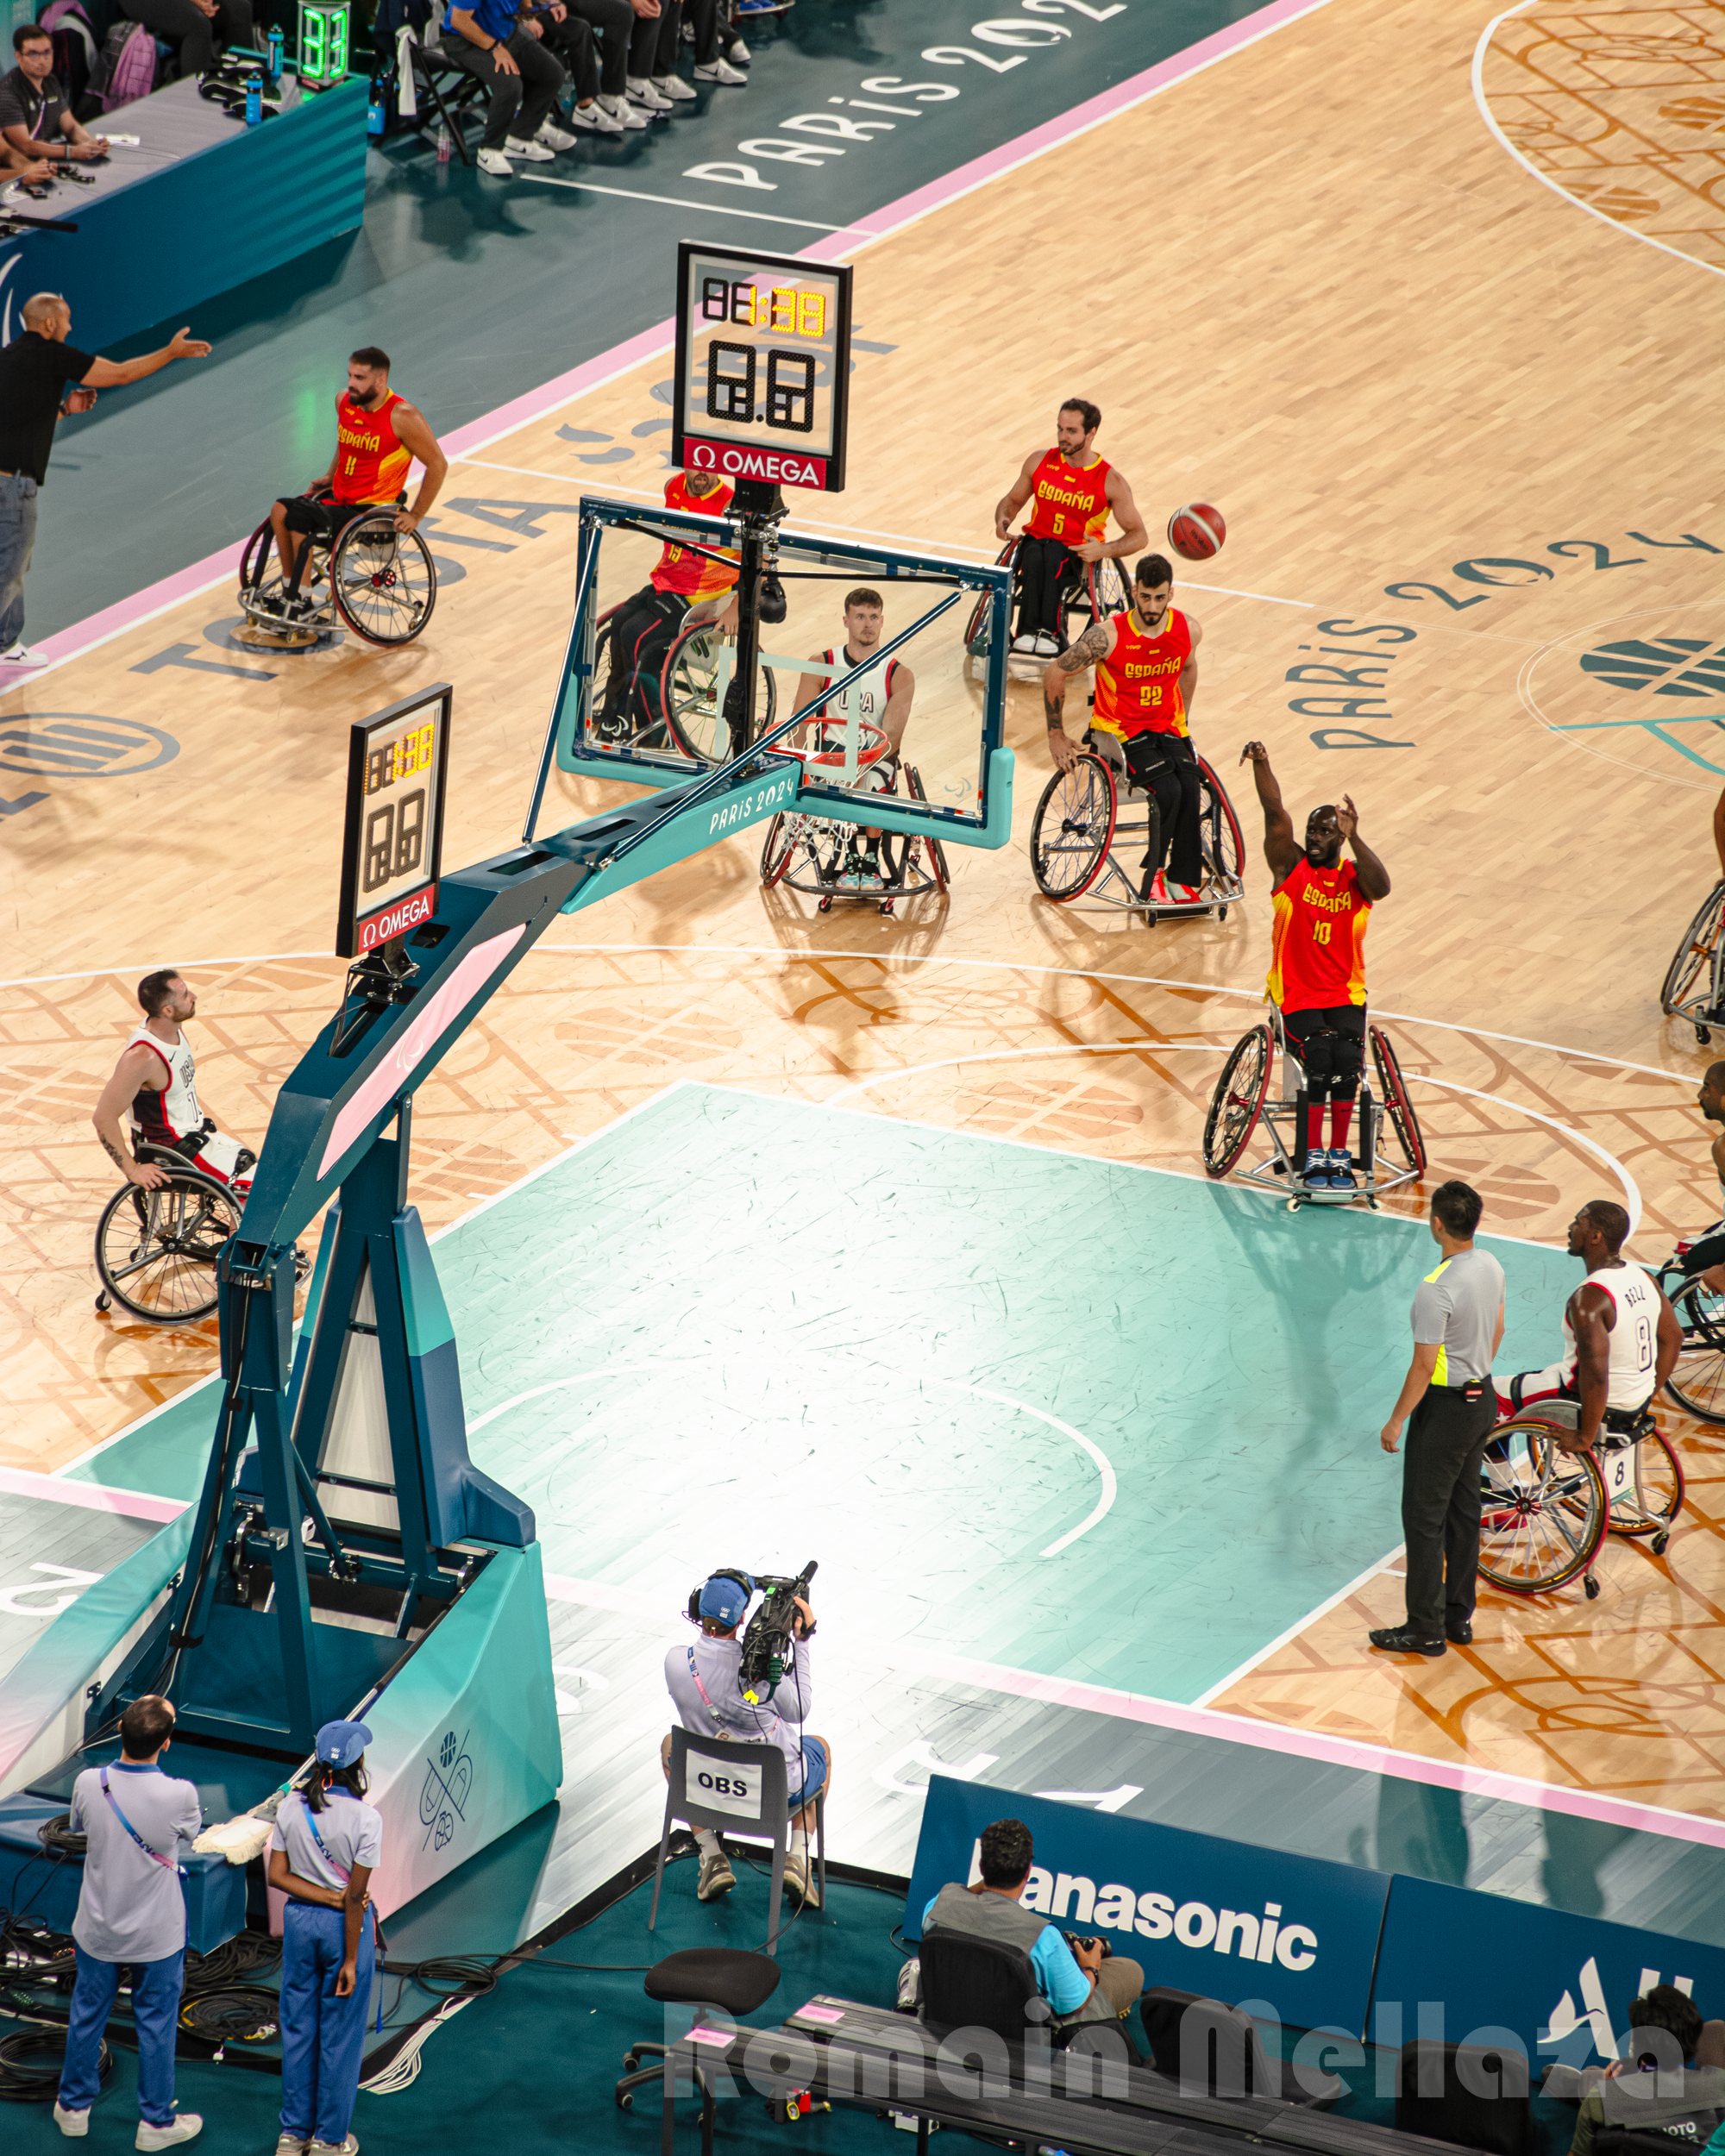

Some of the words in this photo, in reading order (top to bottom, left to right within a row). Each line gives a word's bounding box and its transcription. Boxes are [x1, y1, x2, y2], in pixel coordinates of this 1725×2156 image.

[748, 284, 826, 338] 1:38
[344, 454, 358, 476] 11
[722, 449, 819, 486] OMEGA
[1051, 512, 1066, 535] 5
[1383, 531, 1725, 611] 2024
[838, 689, 875, 713] UA
[1139, 685, 1163, 706] 22
[755, 777, 794, 812] 2024
[378, 894, 430, 939] OMEGA
[1313, 919, 1333, 945] 10
[187, 1091, 203, 1124] 1
[1624, 1284, 1647, 1308] BELL
[1635, 1315, 1653, 1373] 8
[1615, 1460, 1625, 1487] 8
[697, 1771, 748, 1798] OBS
